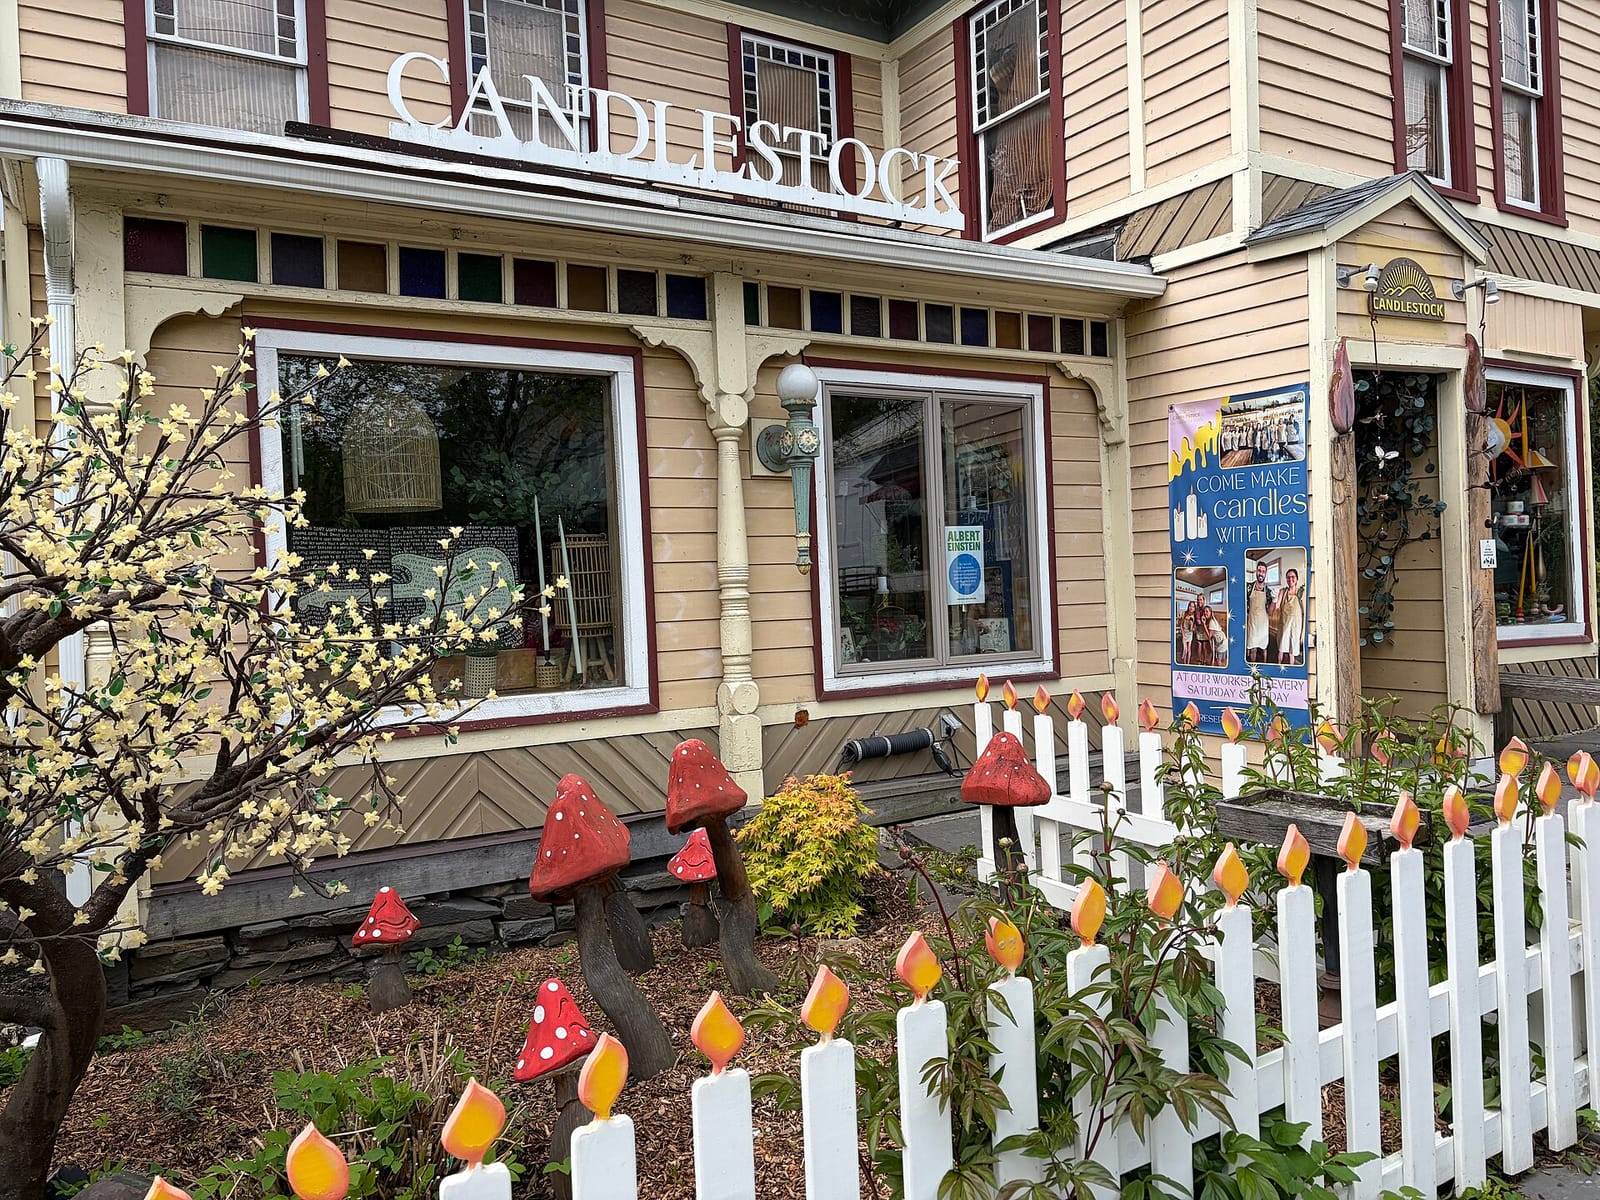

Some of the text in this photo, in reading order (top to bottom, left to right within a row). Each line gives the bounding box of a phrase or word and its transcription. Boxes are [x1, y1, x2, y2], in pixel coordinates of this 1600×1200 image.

[386, 51, 964, 221] CANDLESTOCK
[1373, 296, 1444, 318] CANDLESTOCK
[1196, 466, 1301, 494] COME MAKE
[1213, 488, 1308, 520] candles
[947, 530, 981, 542] ALBERT
[1215, 522, 1296, 544] WITH US!
[947, 541, 981, 552] EINSTEIN
[1176, 672, 1305, 691] AT OUR WORKSH EVERY
[1187, 684, 1237, 698] SATURDAY
[1239, 688, 1247, 700] &
